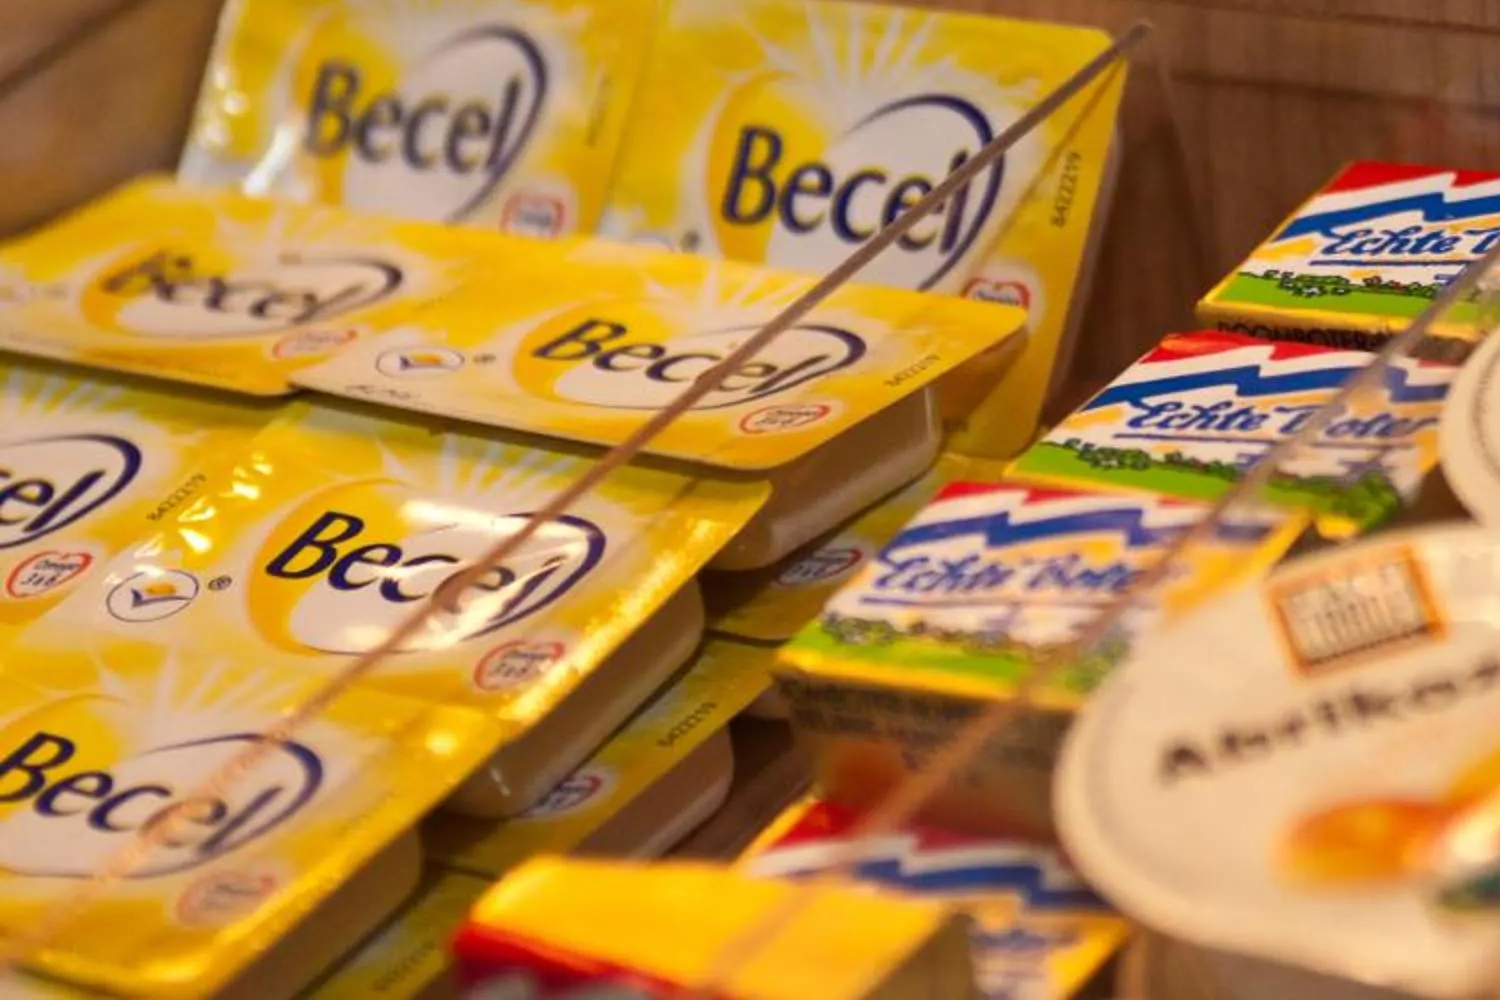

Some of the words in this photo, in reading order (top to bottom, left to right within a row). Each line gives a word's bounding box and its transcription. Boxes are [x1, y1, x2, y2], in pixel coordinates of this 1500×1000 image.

[306, 57, 524, 175] Becel
[721, 125, 971, 255] Becel
[1320, 225, 1464, 256] Echte
[533, 319, 831, 394] Becel
[1126, 400, 1270, 432] Echte
[265, 510, 570, 623] Becel
